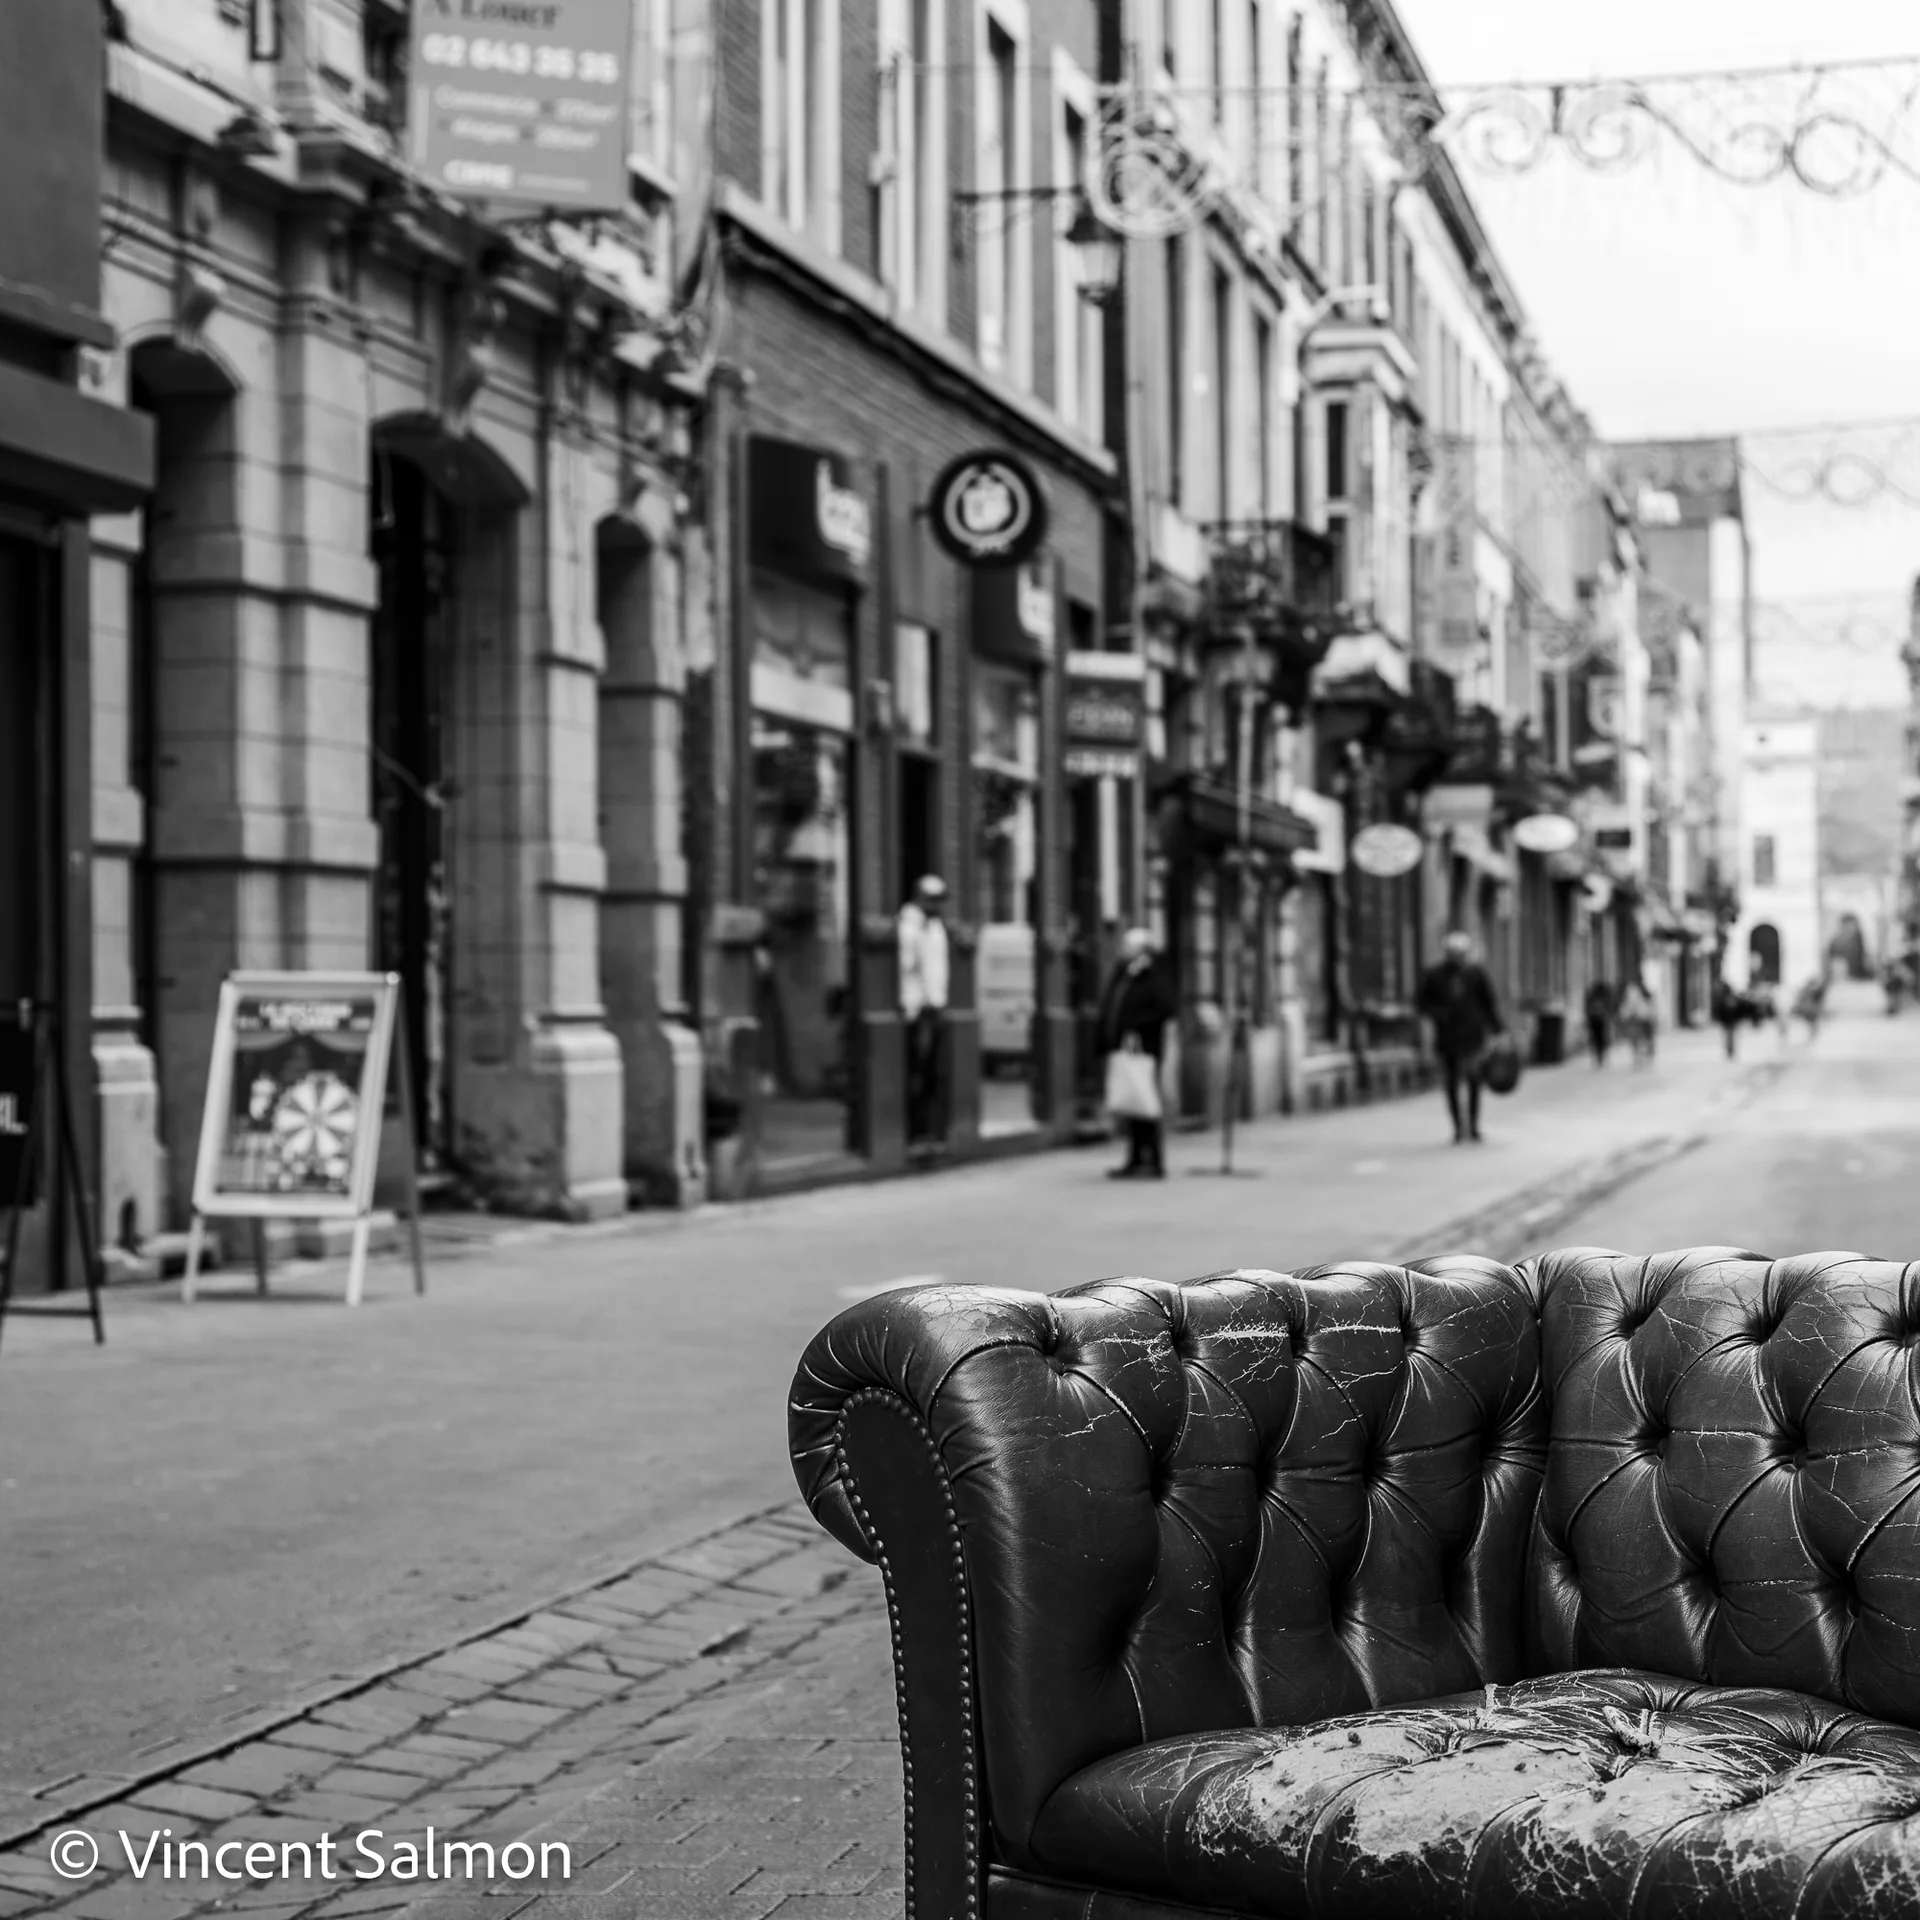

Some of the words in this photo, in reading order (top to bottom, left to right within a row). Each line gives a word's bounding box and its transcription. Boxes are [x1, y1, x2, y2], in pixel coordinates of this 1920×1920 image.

[421, 33, 467, 68] 02
[469, 38, 532, 75] 643
[532, 45, 576, 80] 35
[577, 49, 620, 84] 35
